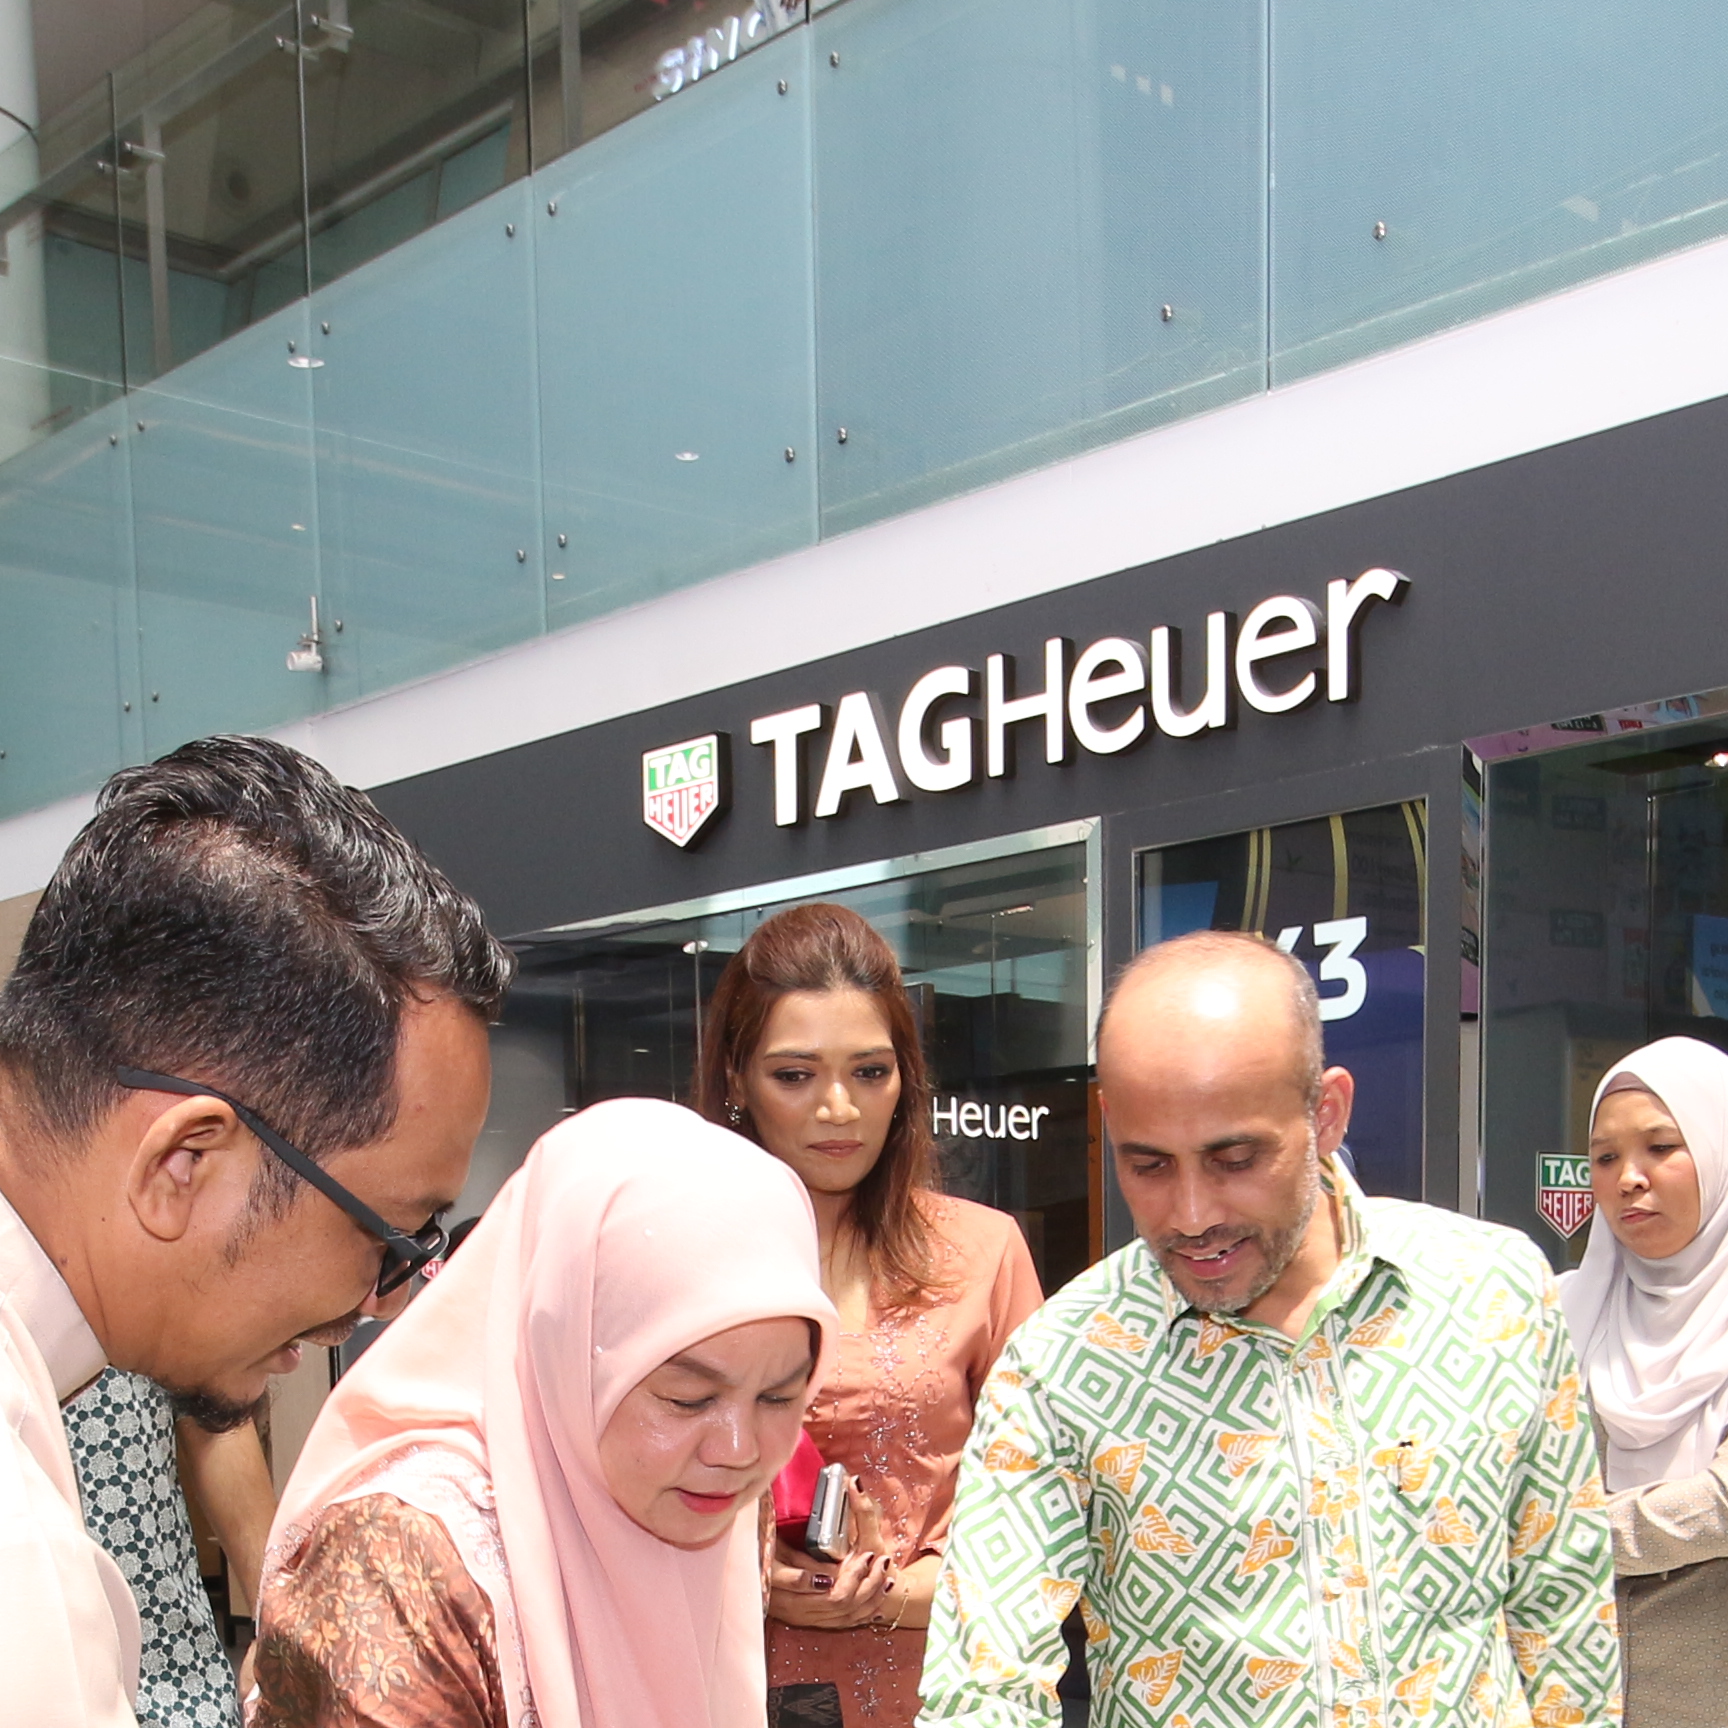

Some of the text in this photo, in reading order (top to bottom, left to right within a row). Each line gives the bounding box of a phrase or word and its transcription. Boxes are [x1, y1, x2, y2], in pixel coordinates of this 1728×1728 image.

[649, 744, 712, 789] TAG
[649, 782, 713, 840] HEUER
[1544, 1159, 1591, 1187] TAG
[1542, 1192, 1593, 1232] HEUER
